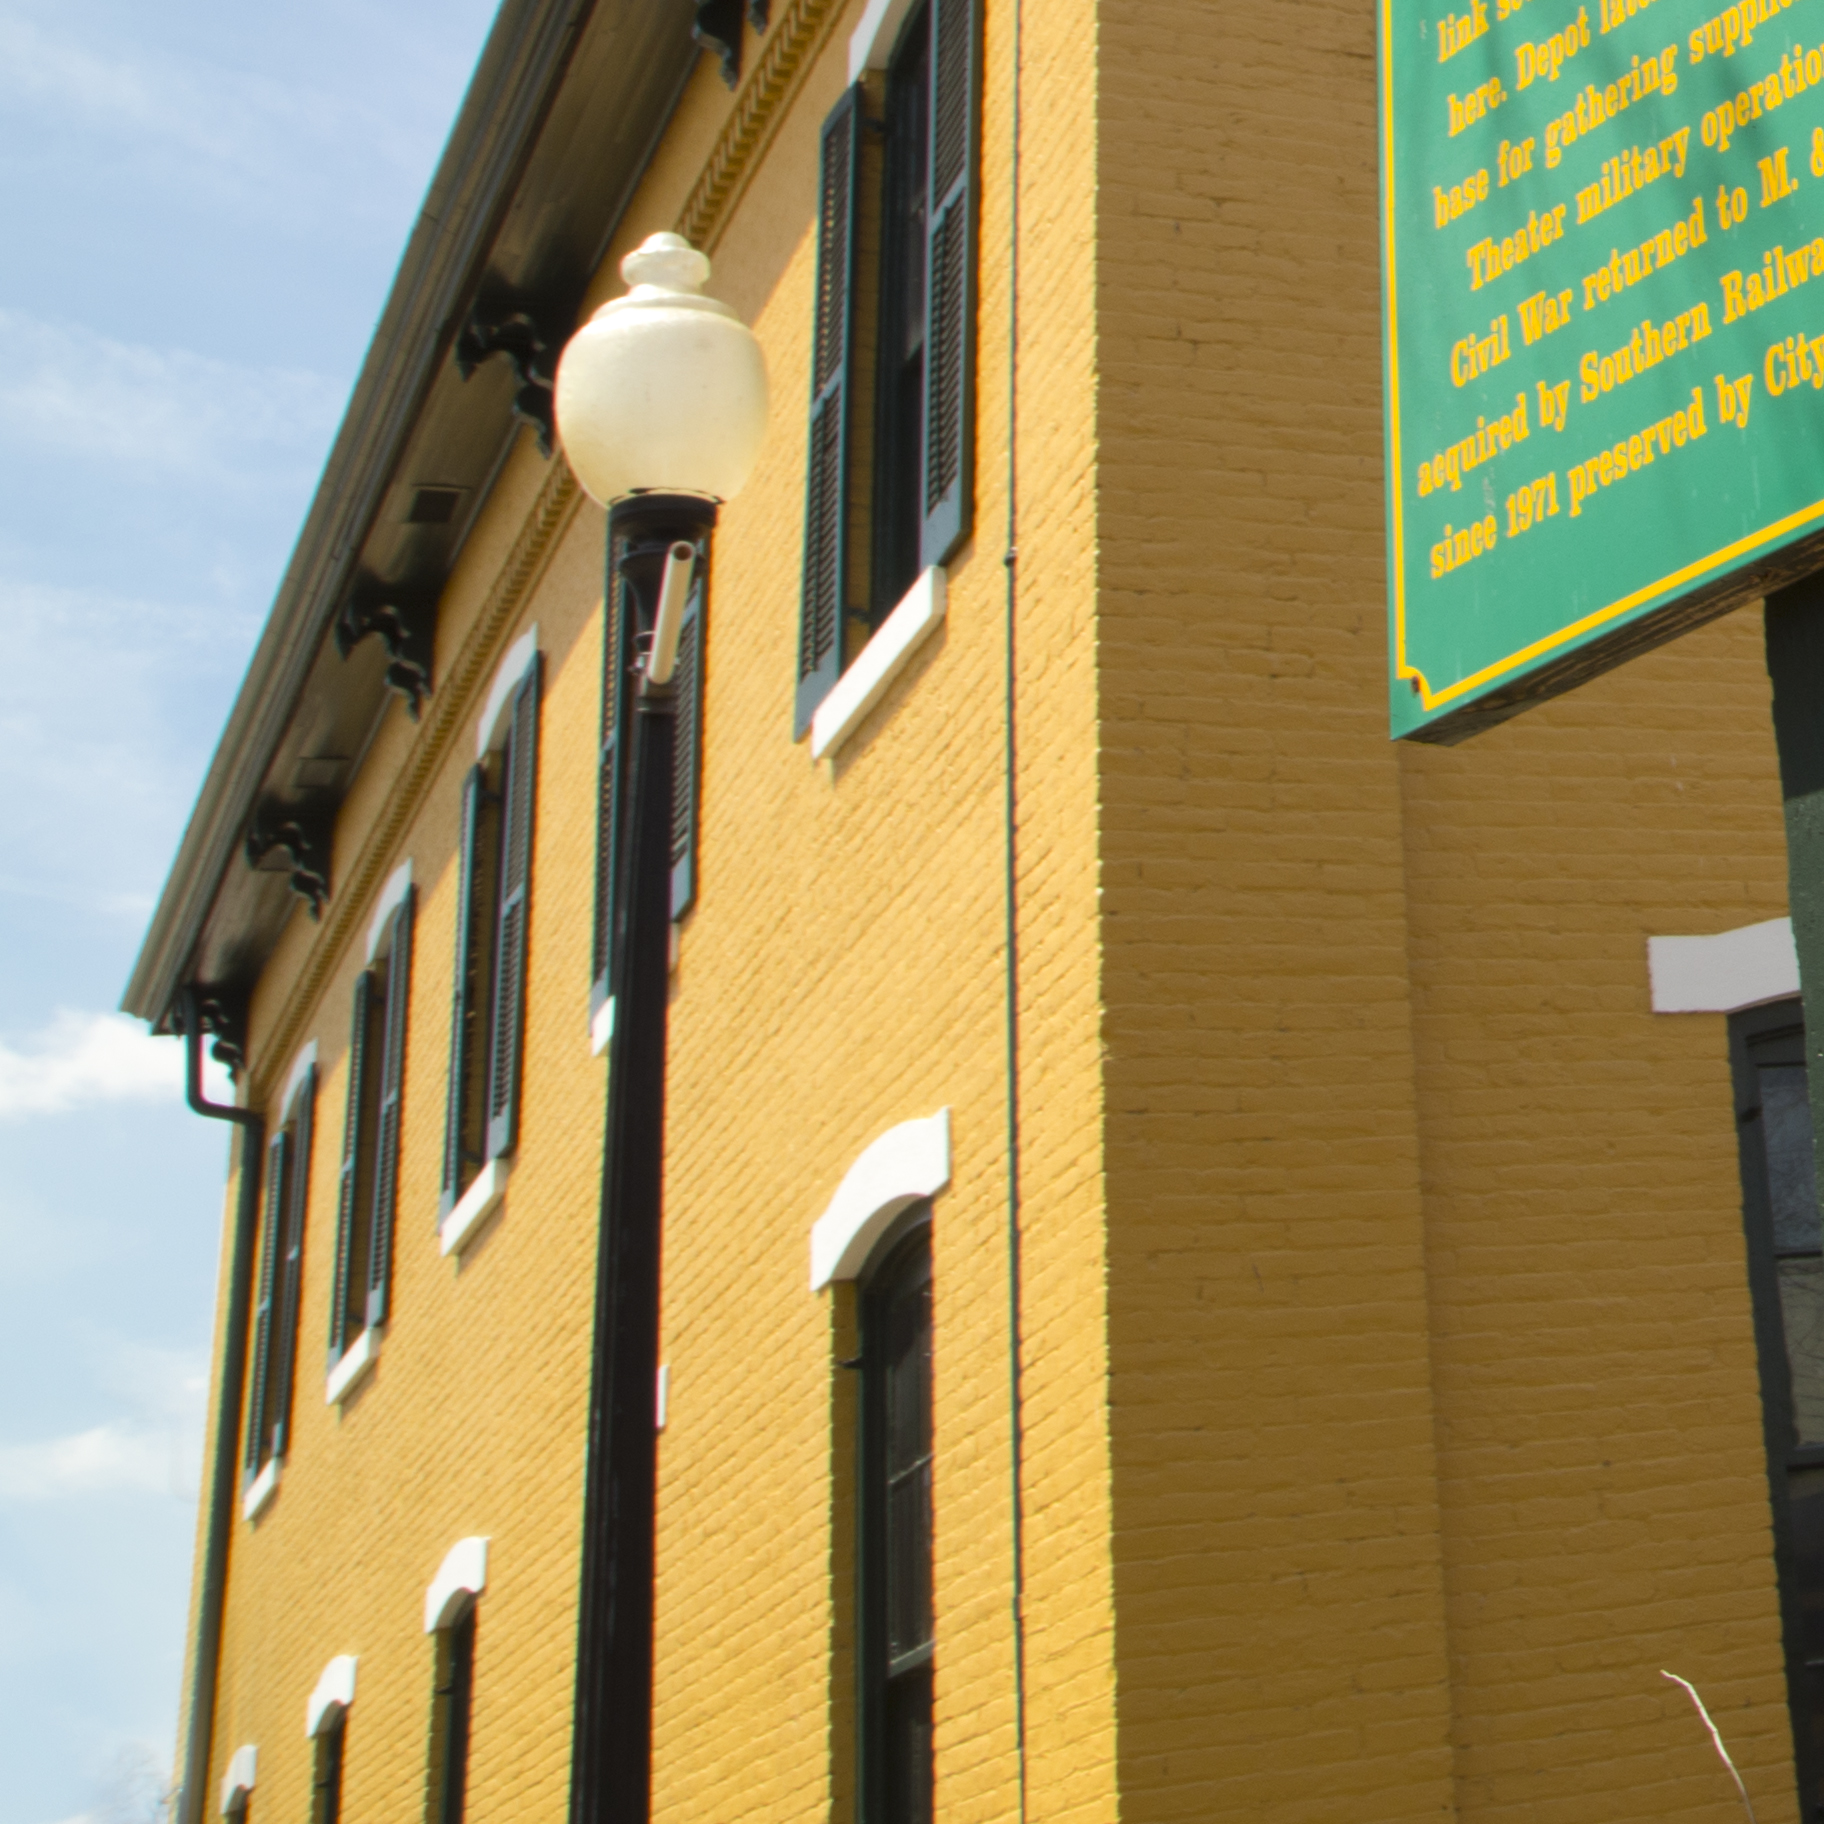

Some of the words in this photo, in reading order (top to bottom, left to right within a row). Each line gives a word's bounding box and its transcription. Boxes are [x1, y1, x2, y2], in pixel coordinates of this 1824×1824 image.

[1431, 167, 1491, 231] base
[1495, 135, 1537, 189] for
[1543, 42, 1680, 171] gathering
[1446, 75, 1509, 139] here.
[1513, 4, 1592, 93] Depot
[1449, 313, 1513, 389] Civil
[1516, 287, 1575, 347] War
[1581, 195, 1709, 312] returned
[1714, 184, 1750, 232] to
[1755, 145, 1800, 209] M.
[1465, 202, 1568, 293] Theater
[1574, 125, 1692, 226] military
[1416, 391, 1532, 499] acquired
[1535, 378, 1572, 434] by
[1578, 300, 1714, 405] Southern
[1429, 513, 1499, 581] since
[1504, 470, 1562, 540] 1971
[1566, 385, 1709, 519] preserved
[1713, 372, 1755, 430] by
